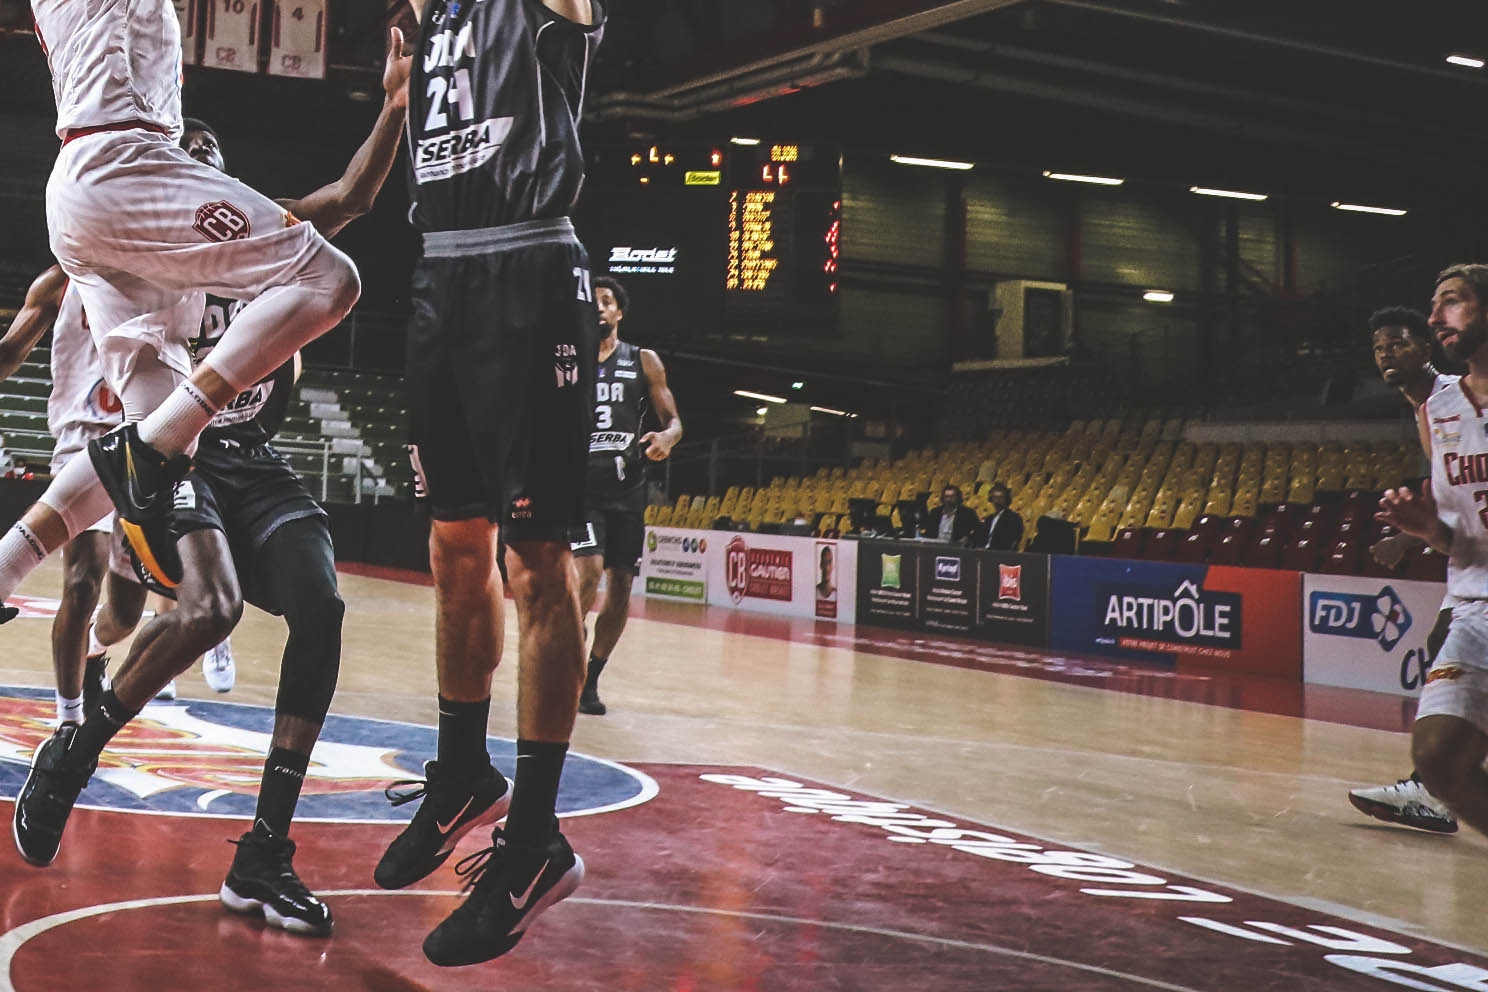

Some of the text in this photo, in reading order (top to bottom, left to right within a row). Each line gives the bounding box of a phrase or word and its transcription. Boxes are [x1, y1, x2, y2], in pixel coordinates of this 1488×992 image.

[291, 6, 305, 22] 4
[423, 21, 476, 74] JDA
[203, 207, 244, 241] CB
[609, 246, 677, 262] Bodet
[595, 382, 624, 402] DA
[594, 405, 612, 429] 3
[589, 433, 627, 445] SERBA
[728, 551, 746, 588] CB
[750, 563, 791, 582] GAUTIER
[1104, 579, 1231, 638] ARTIPÔLE
[1314, 599, 1361, 628] FDJ
[698, 772, 1233, 904] Logistique
